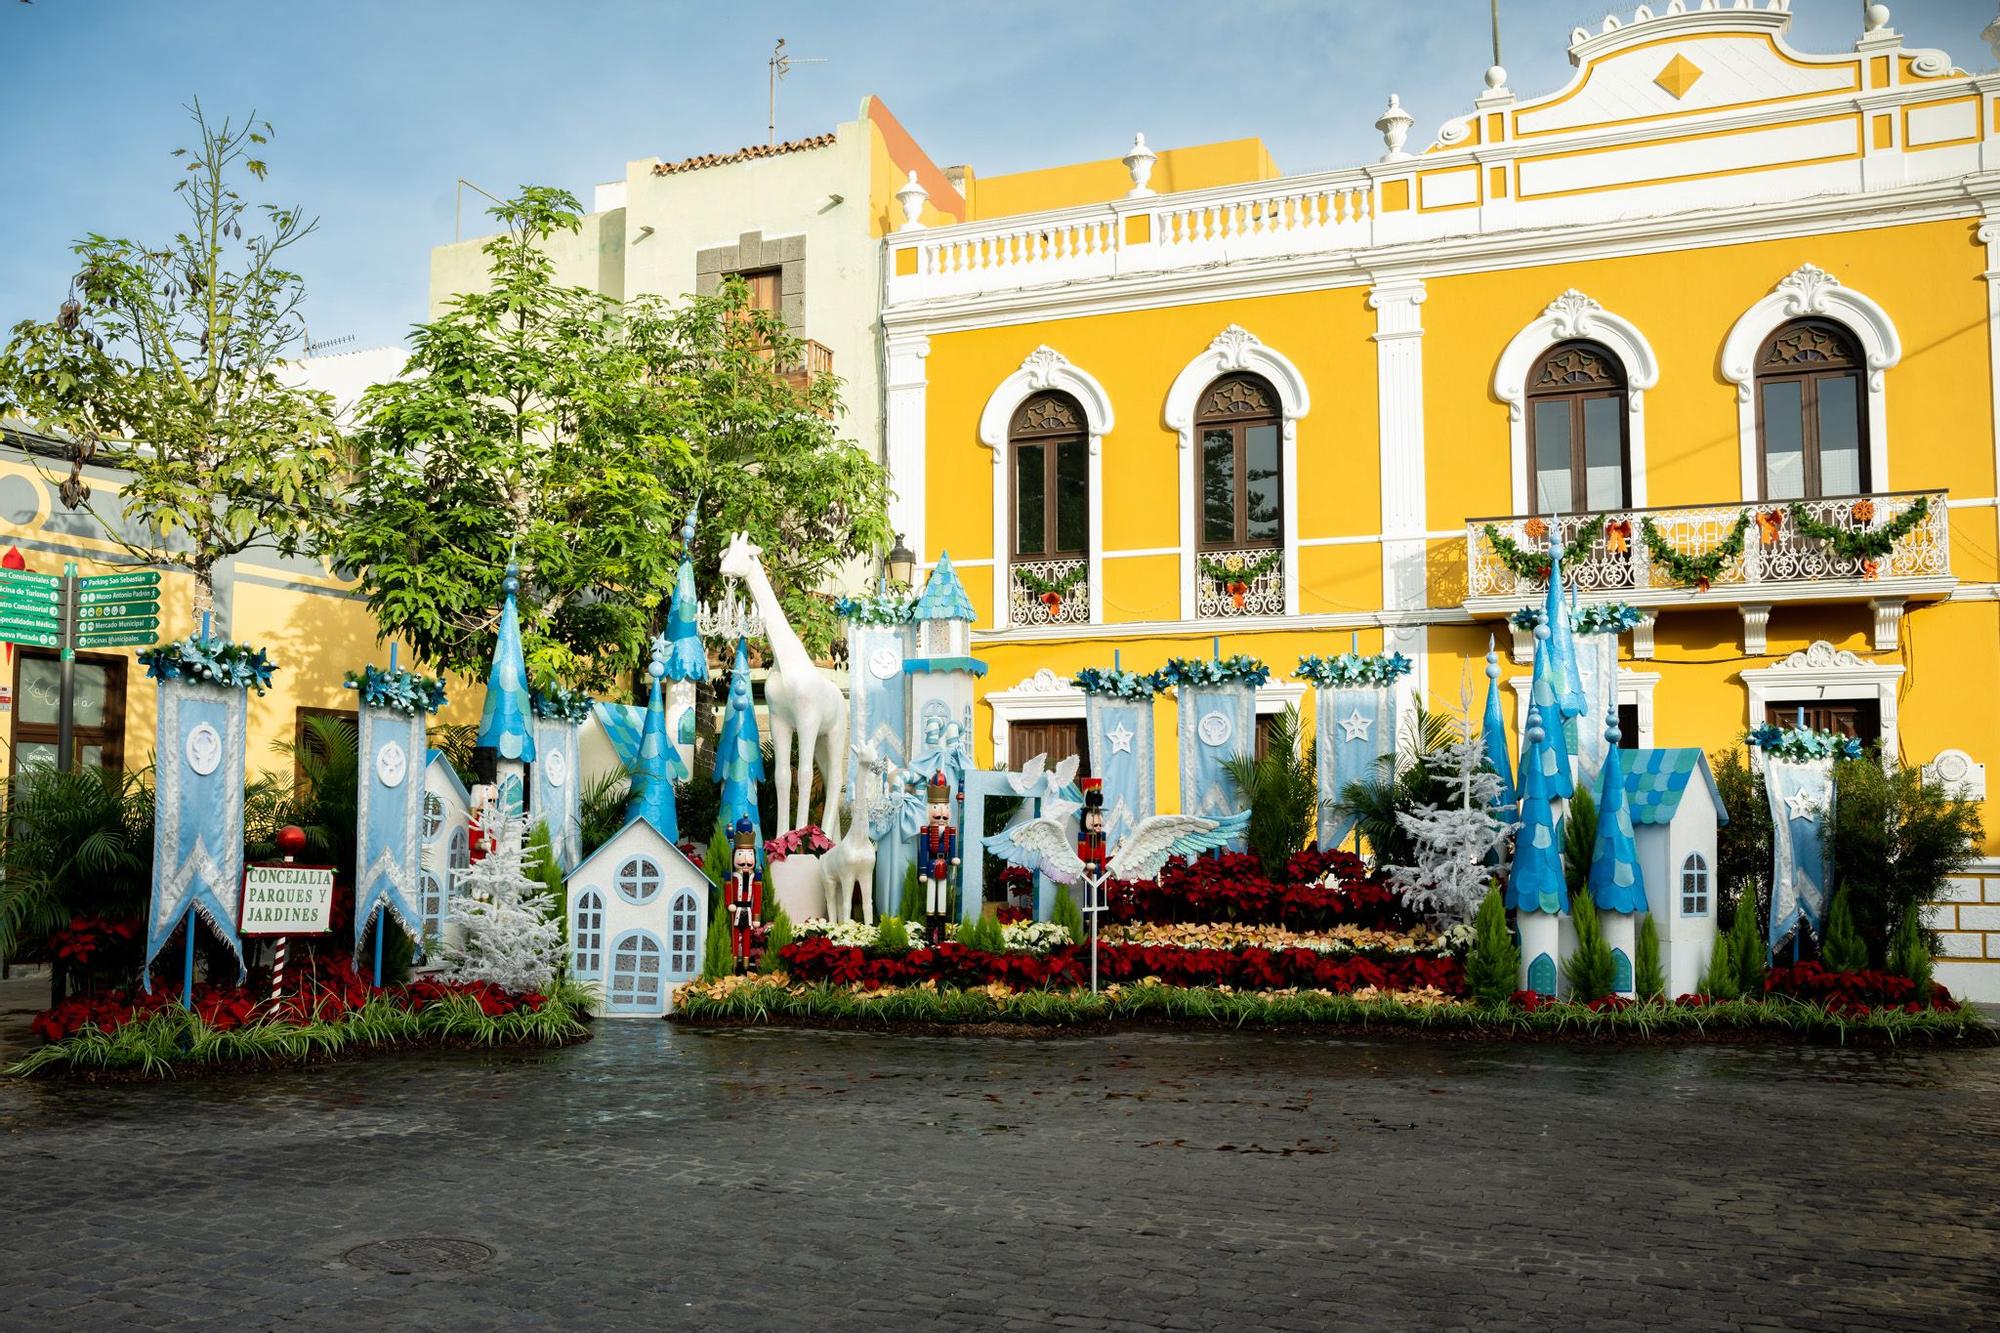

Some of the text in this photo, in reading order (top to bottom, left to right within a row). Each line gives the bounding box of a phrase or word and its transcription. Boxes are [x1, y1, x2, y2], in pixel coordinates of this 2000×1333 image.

[8, 572, 49, 584] Consistoriales
[26, 589, 49, 599] Turismo
[13, 602, 49, 614] Consistorial
[95, 620, 145, 629] Mercado Municipal
[16, 632, 39, 641] Pintada
[86, 635, 139, 645] Oficinas Municipales
[1816, 685, 1825, 698] 7
[249, 869, 331, 885] CONCEJALIA
[249, 888, 327, 903] PARQUES Y
[247, 907, 319, 922] JARDINES
